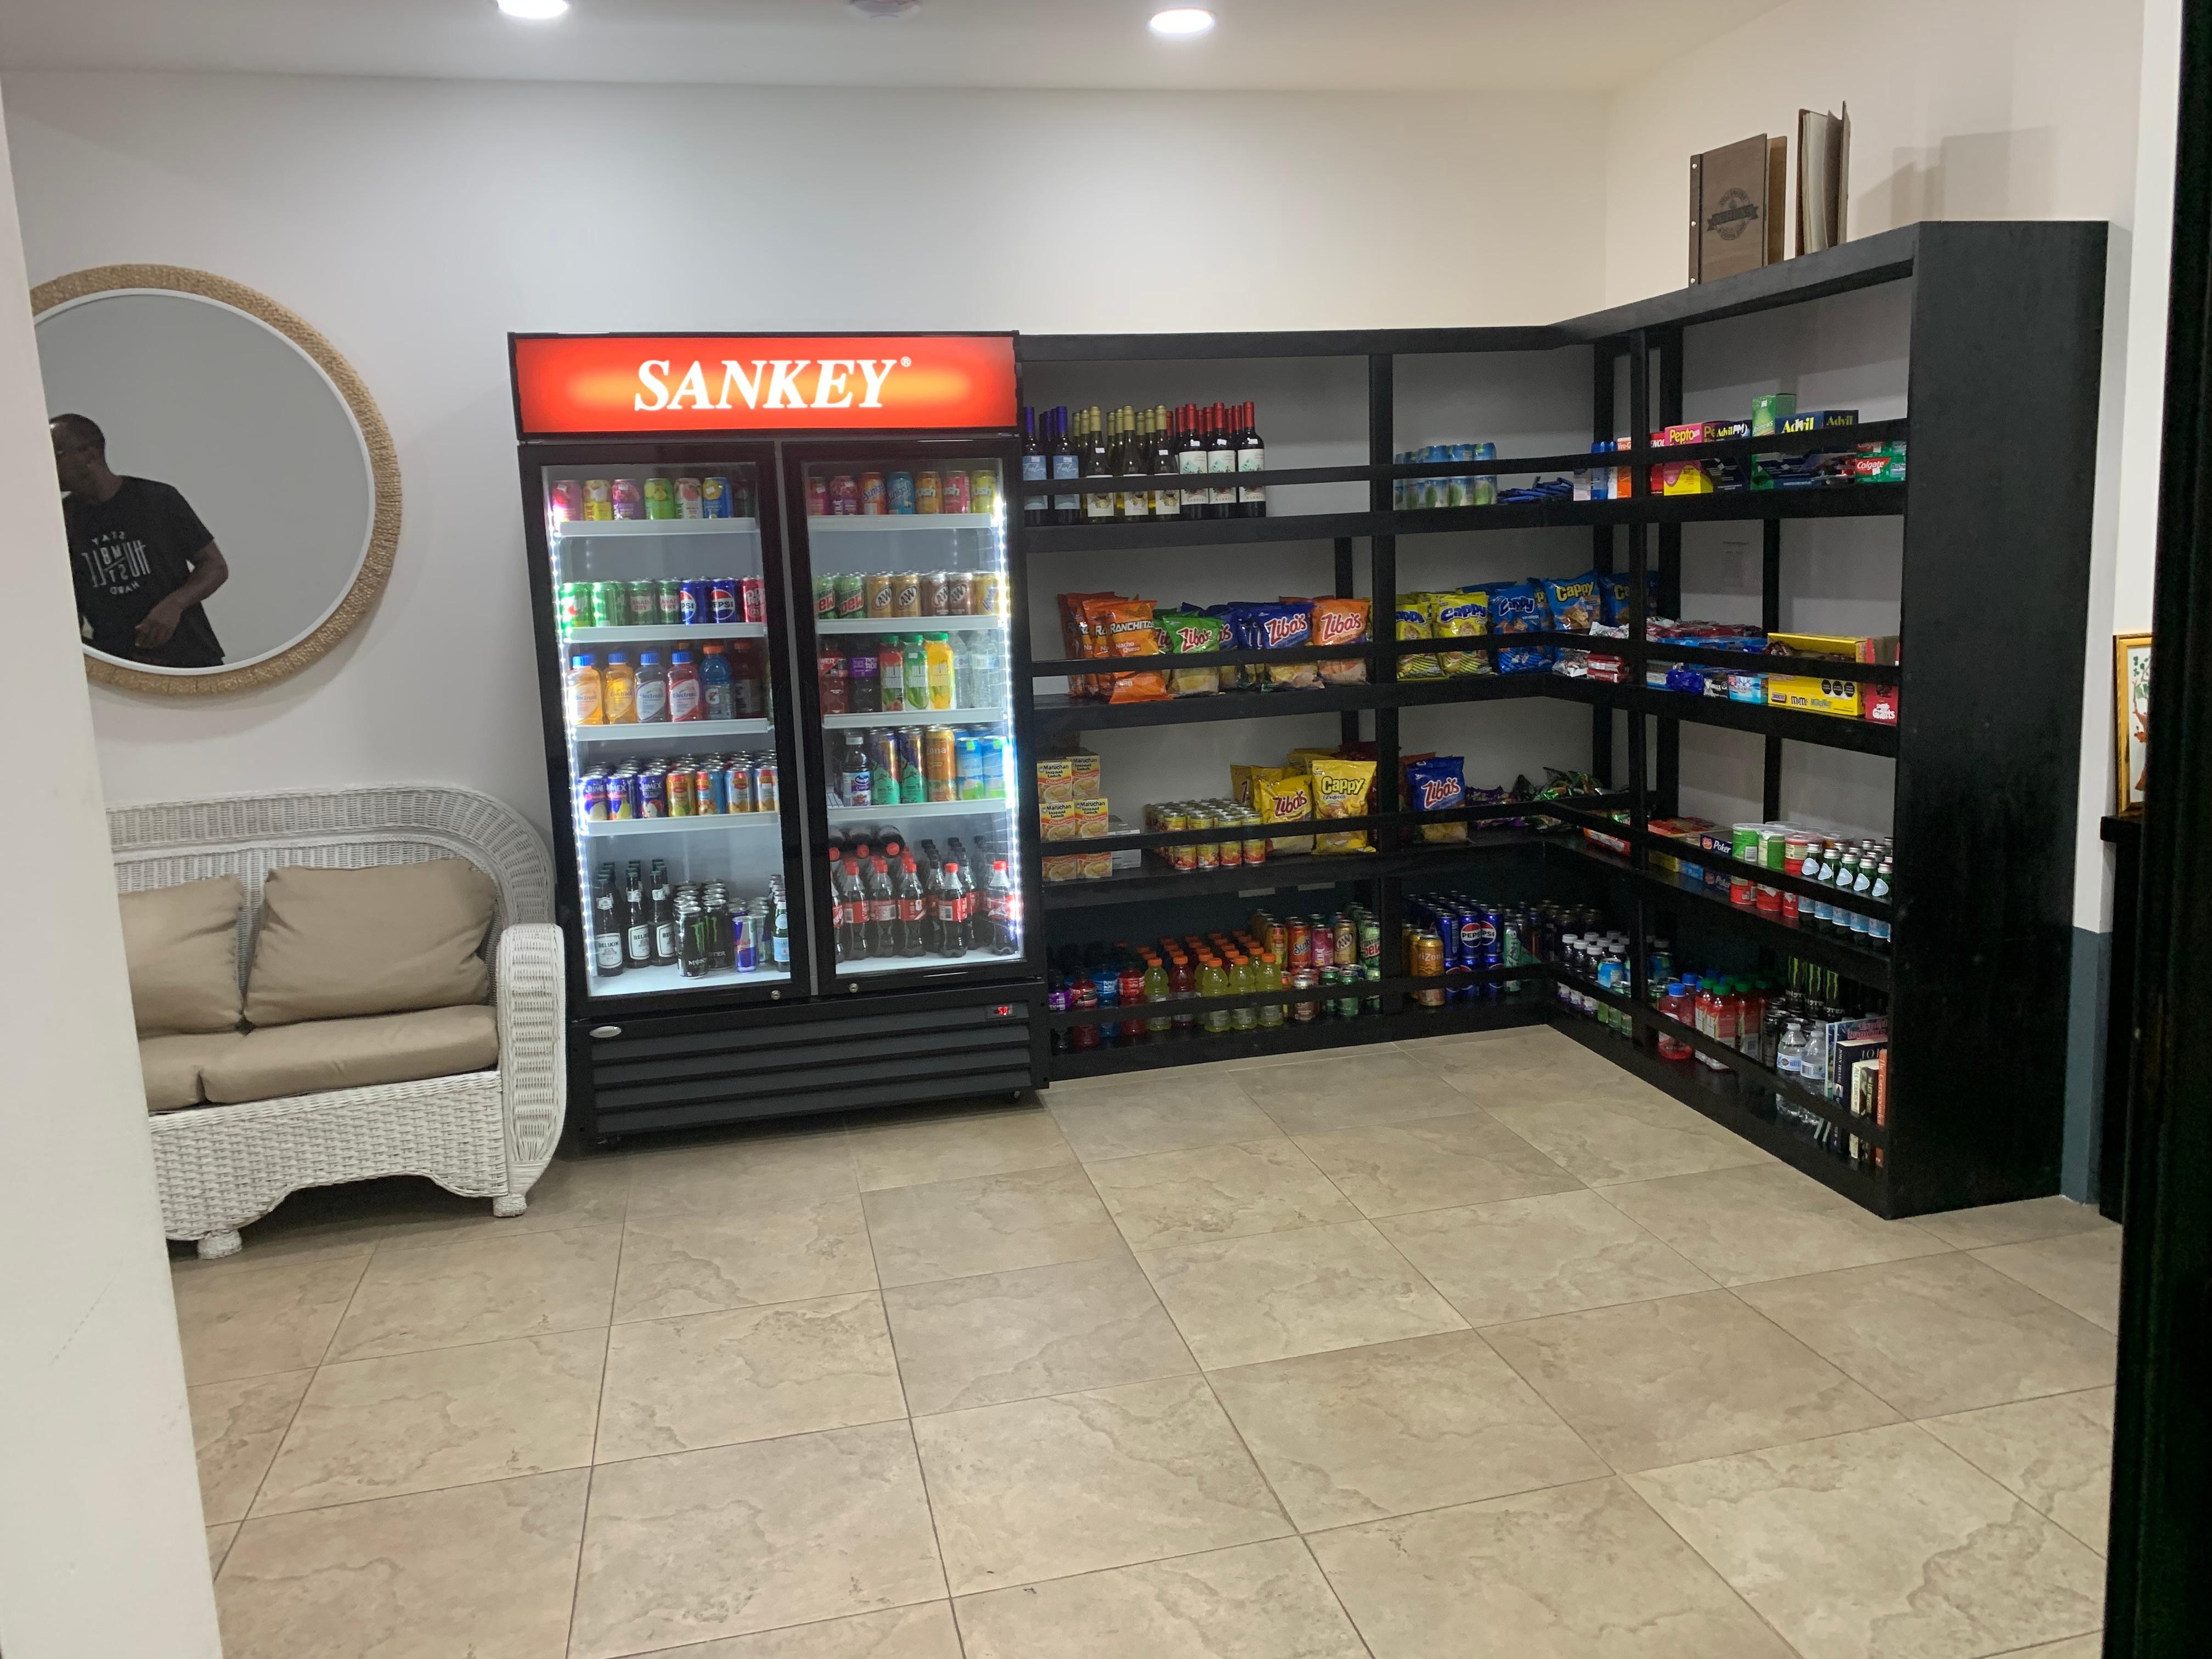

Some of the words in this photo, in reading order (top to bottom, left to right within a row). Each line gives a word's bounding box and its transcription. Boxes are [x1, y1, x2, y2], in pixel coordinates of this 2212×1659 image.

[635, 359, 898, 411] SANKEY
[1781, 417, 1815, 433] Advil
[1669, 428, 1694, 444] Pepto
[1717, 426, 1733, 437] Advil
[1651, 438, 1664, 448] ENOL
[1857, 460, 1885, 470] Colgate
[1556, 581, 1594, 602] Cappy
[926, 747, 947, 755] Zona
[585, 785, 604, 793] JUME
[640, 782, 662, 791] JUMEX
[1321, 775, 1365, 795] Cappy
[1713, 840, 1731, 854] Poker
